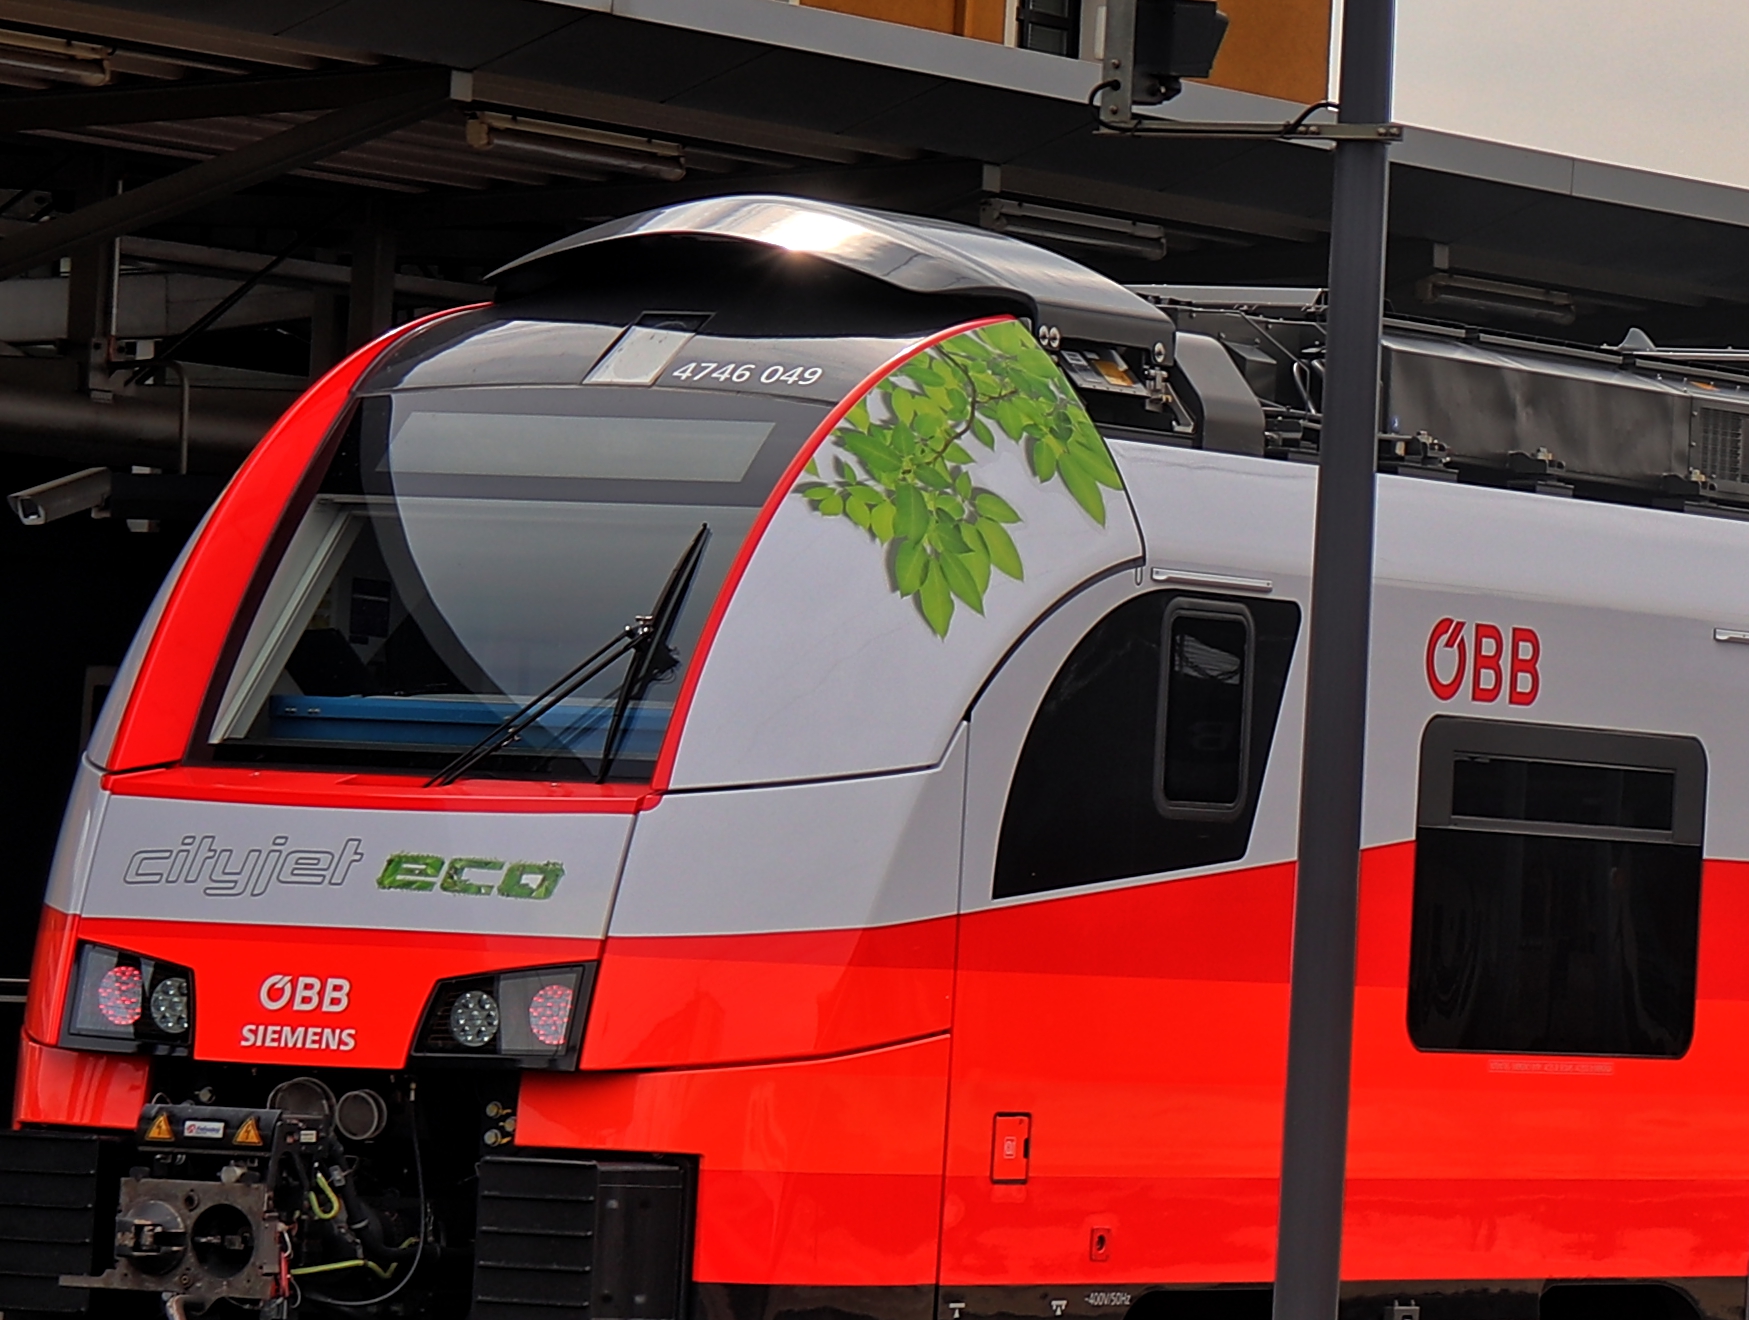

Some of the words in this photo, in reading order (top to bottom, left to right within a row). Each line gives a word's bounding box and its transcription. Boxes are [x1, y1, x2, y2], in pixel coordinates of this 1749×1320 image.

[672, 362, 756, 383] 4746
[759, 365, 823, 386] 049
[1424, 615, 1542, 708] ÖBB
[122, 835, 365, 897] cityjet
[376, 851, 566, 900] eco
[259, 974, 351, 1013] ÖBB
[240, 1024, 356, 1052] SIEMENS
